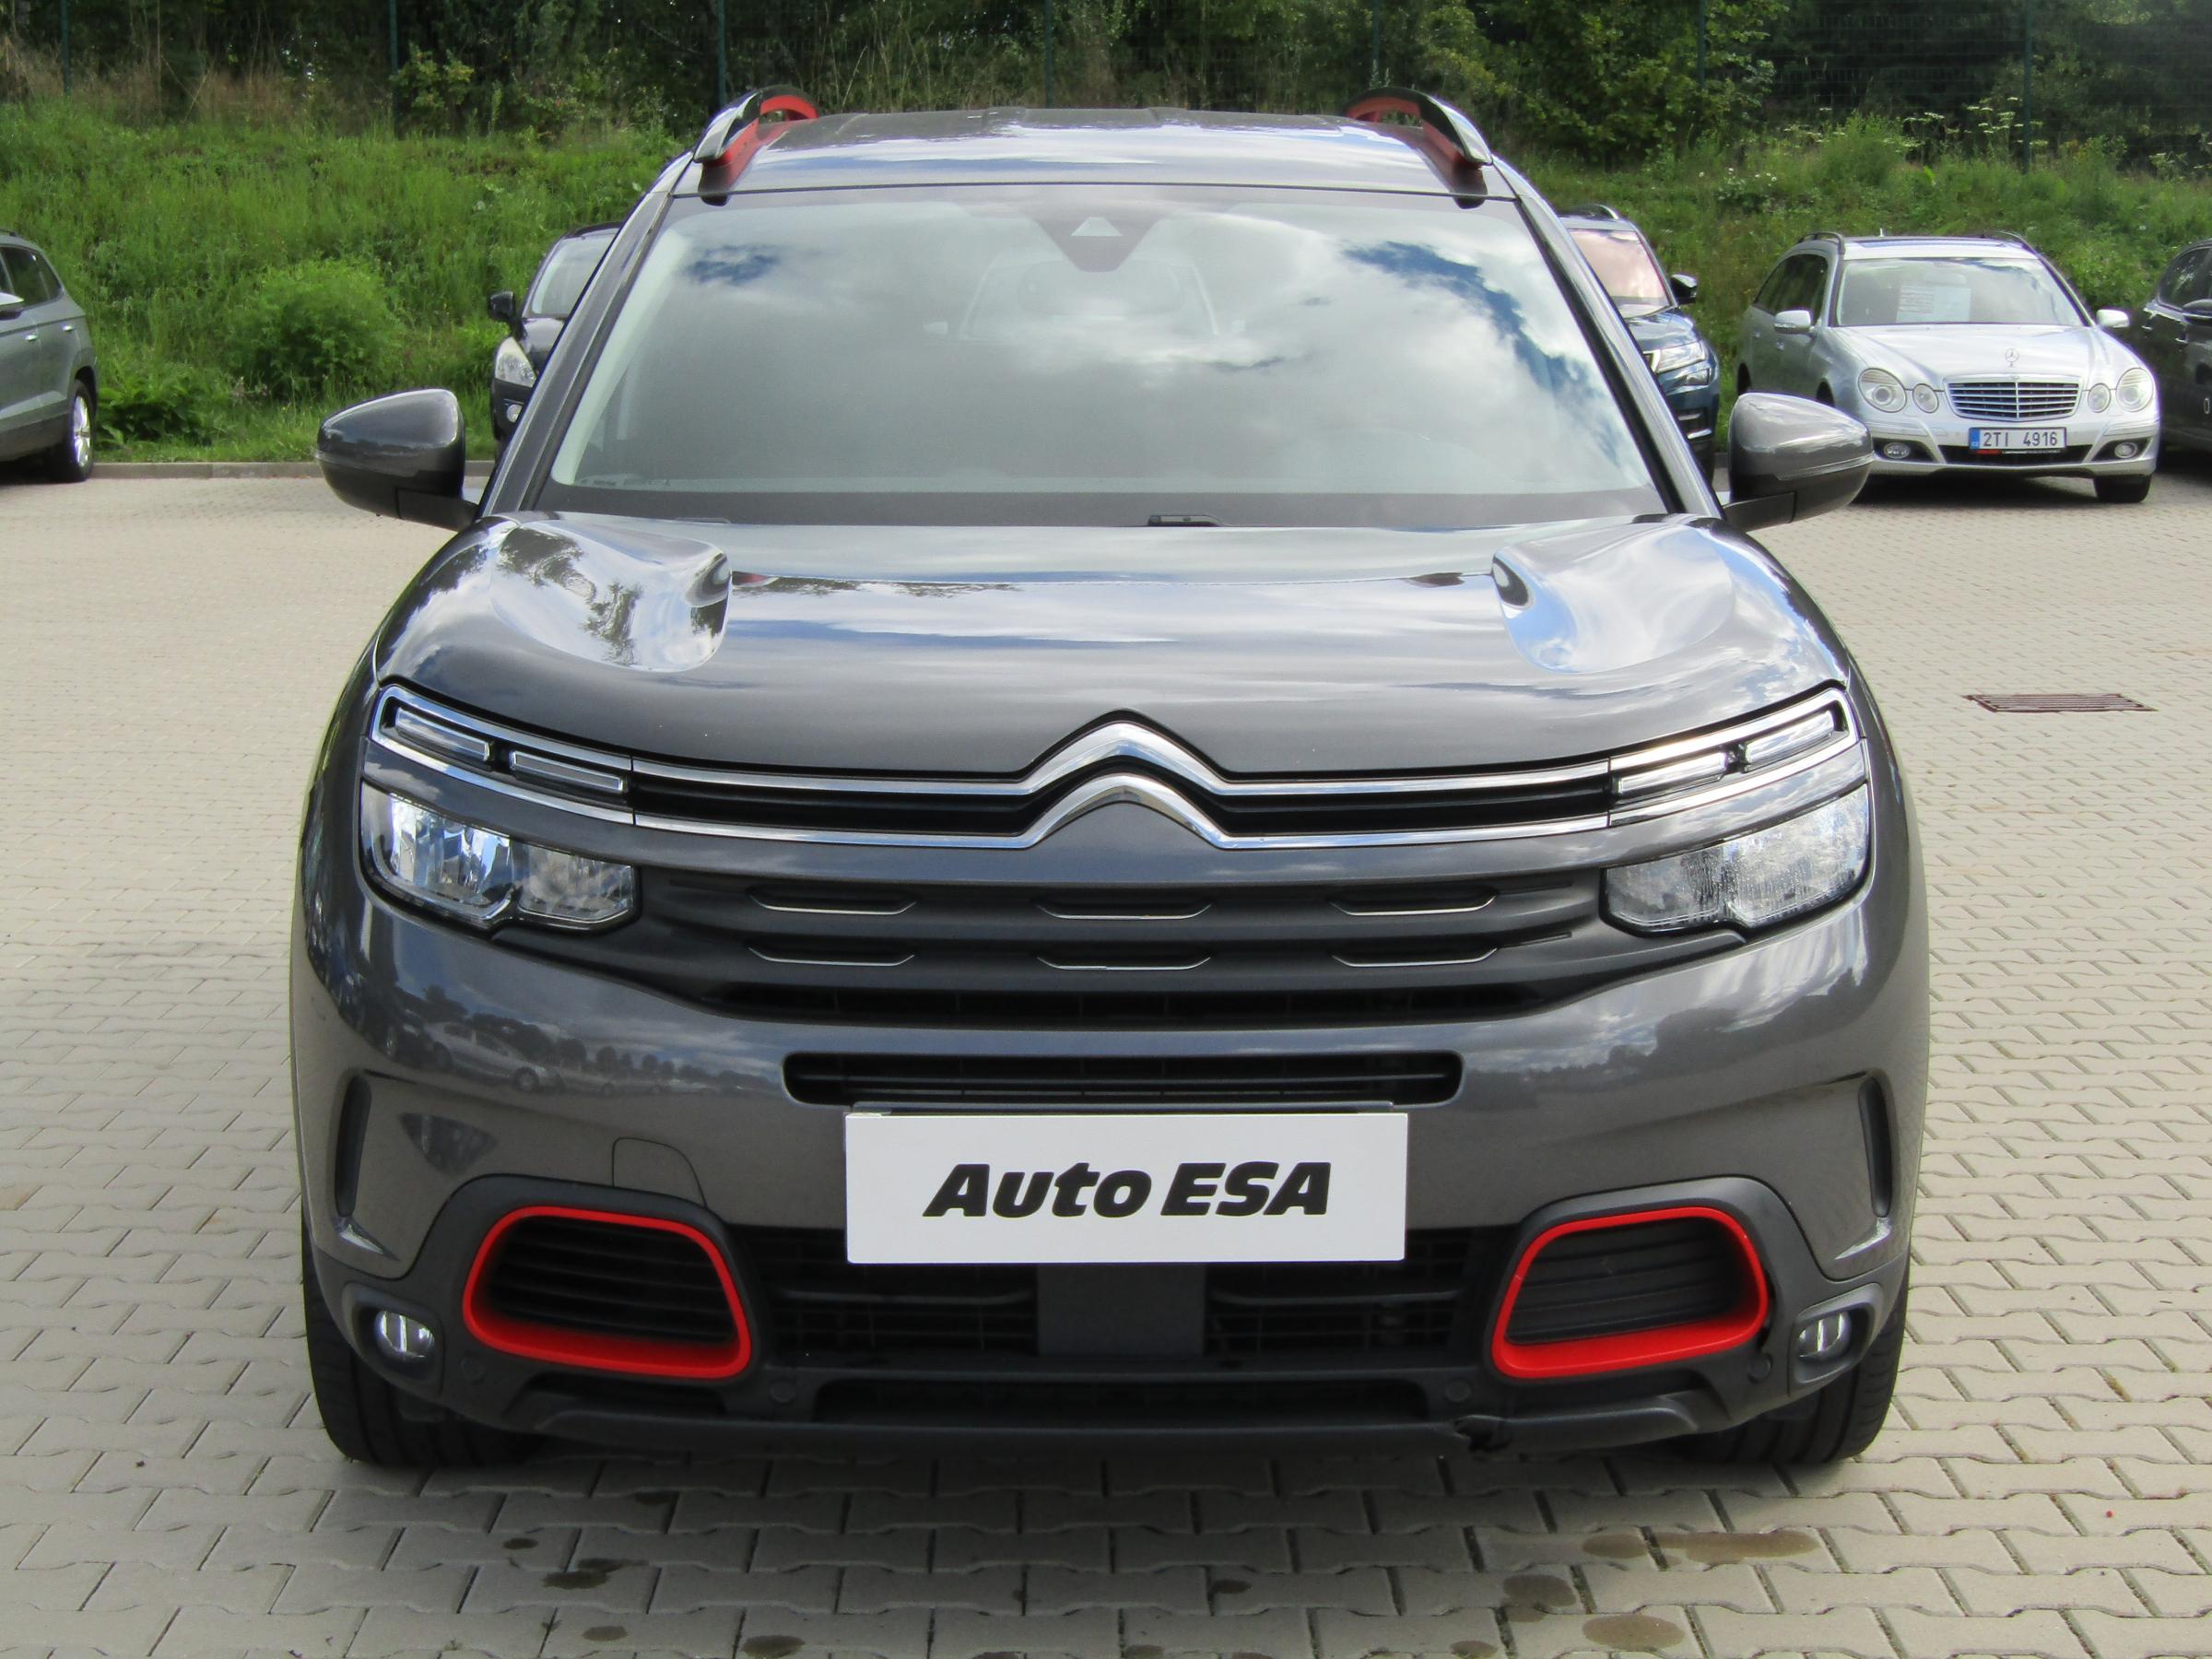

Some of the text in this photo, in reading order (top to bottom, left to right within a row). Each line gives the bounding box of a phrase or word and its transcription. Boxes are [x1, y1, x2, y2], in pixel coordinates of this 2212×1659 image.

[1983, 431, 2008, 447] 2TI
[2023, 431, 2058, 447] 4916
[923, 1161, 1331, 1218] Auto ESA
